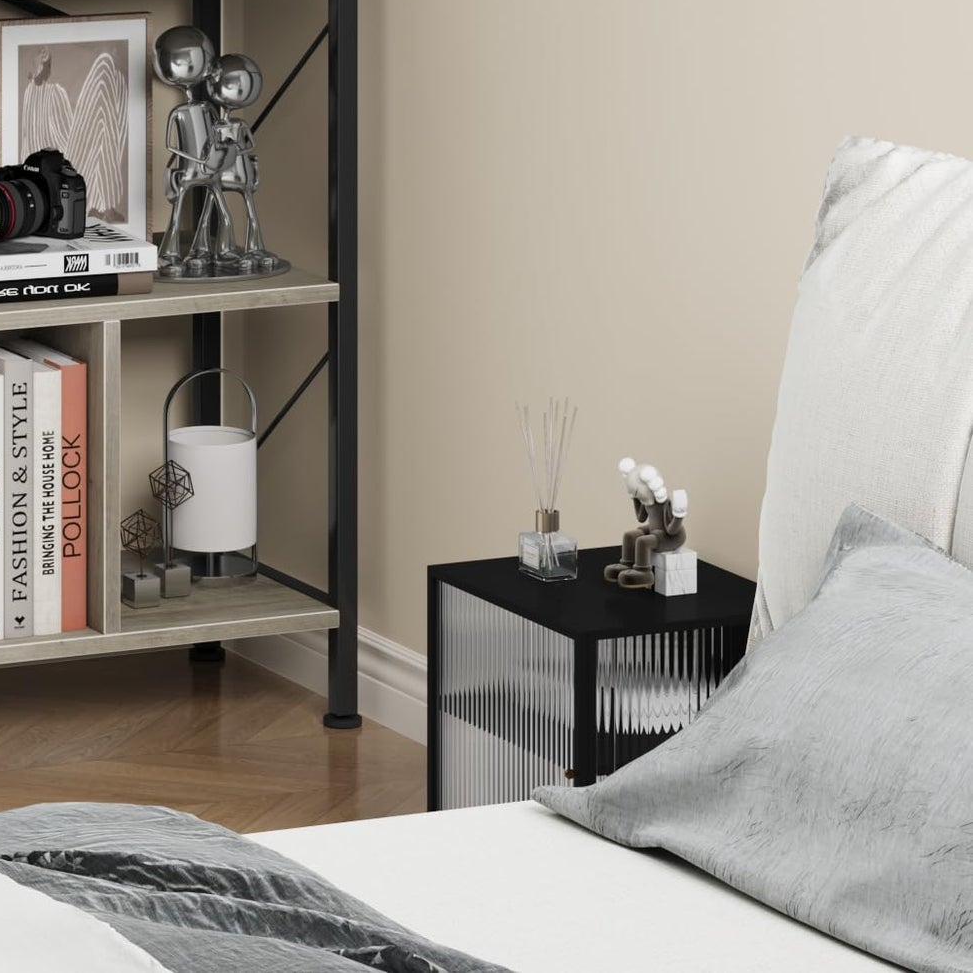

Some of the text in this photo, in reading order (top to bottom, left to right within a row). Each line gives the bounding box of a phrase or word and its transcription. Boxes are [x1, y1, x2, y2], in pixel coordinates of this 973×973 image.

[12, 381, 28, 603] FASHION & STYLE
[43, 430, 55, 576] BRINGING THE HOUSE HOME
[62, 434, 81, 558] POLLOCK
